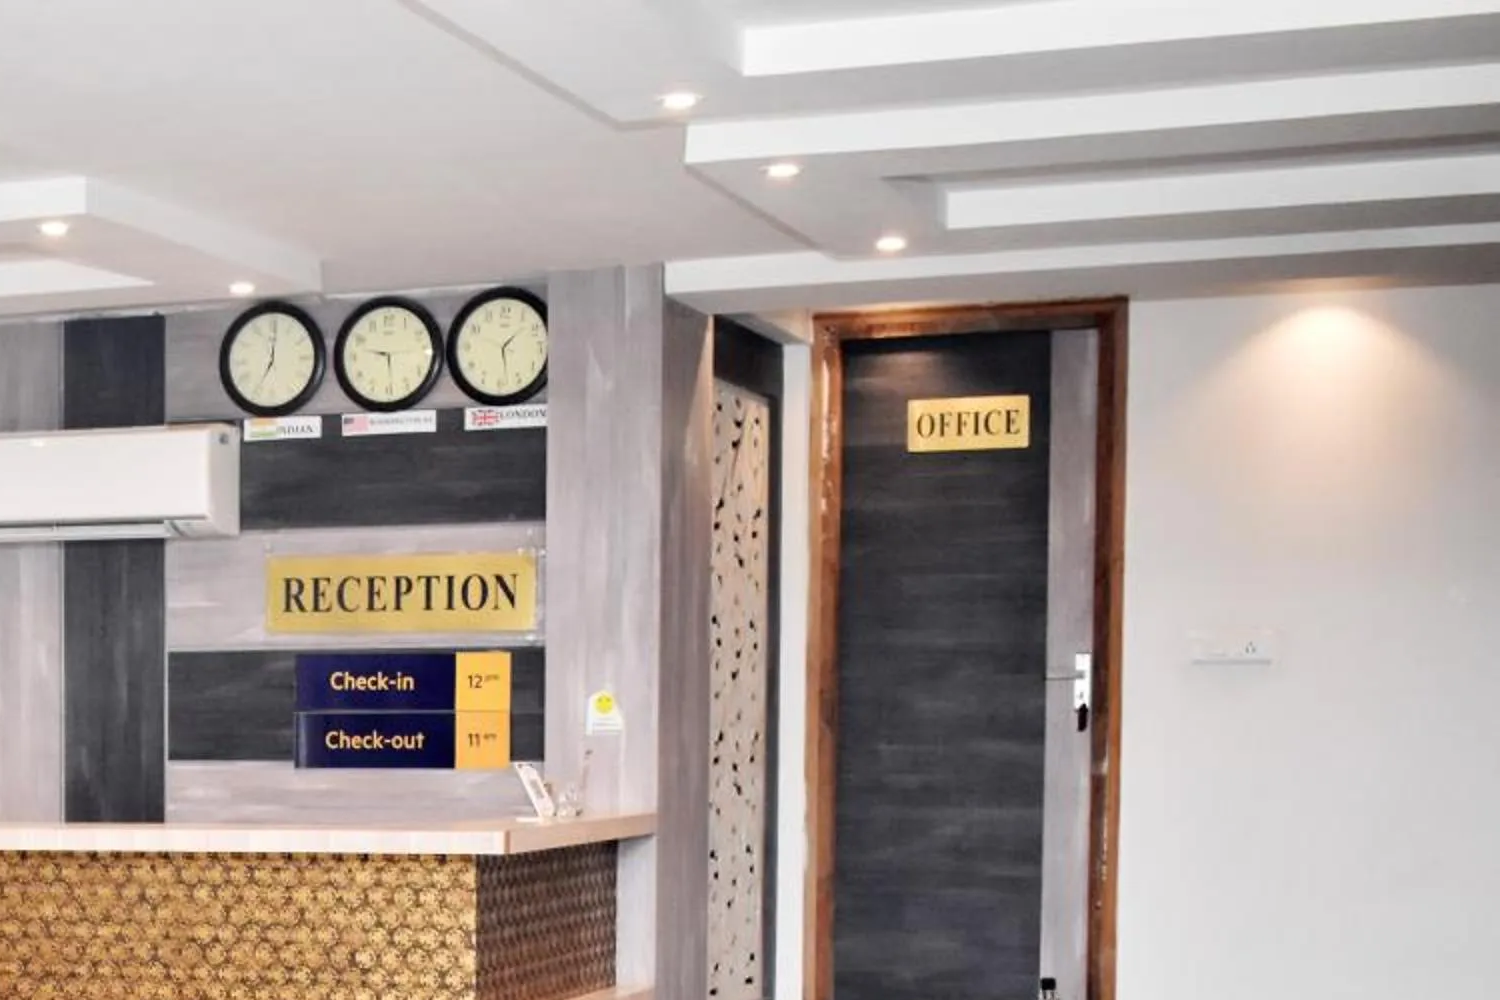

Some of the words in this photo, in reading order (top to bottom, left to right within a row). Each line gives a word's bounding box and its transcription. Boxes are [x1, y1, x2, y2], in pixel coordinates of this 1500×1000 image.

[916, 409, 1021, 438] OFFICE
[282, 573, 519, 613] RECEPTION
[329, 671, 415, 691] Check-in
[467, 674, 483, 688] 12
[324, 730, 425, 749] Check-out
[467, 732, 481, 747] 11
